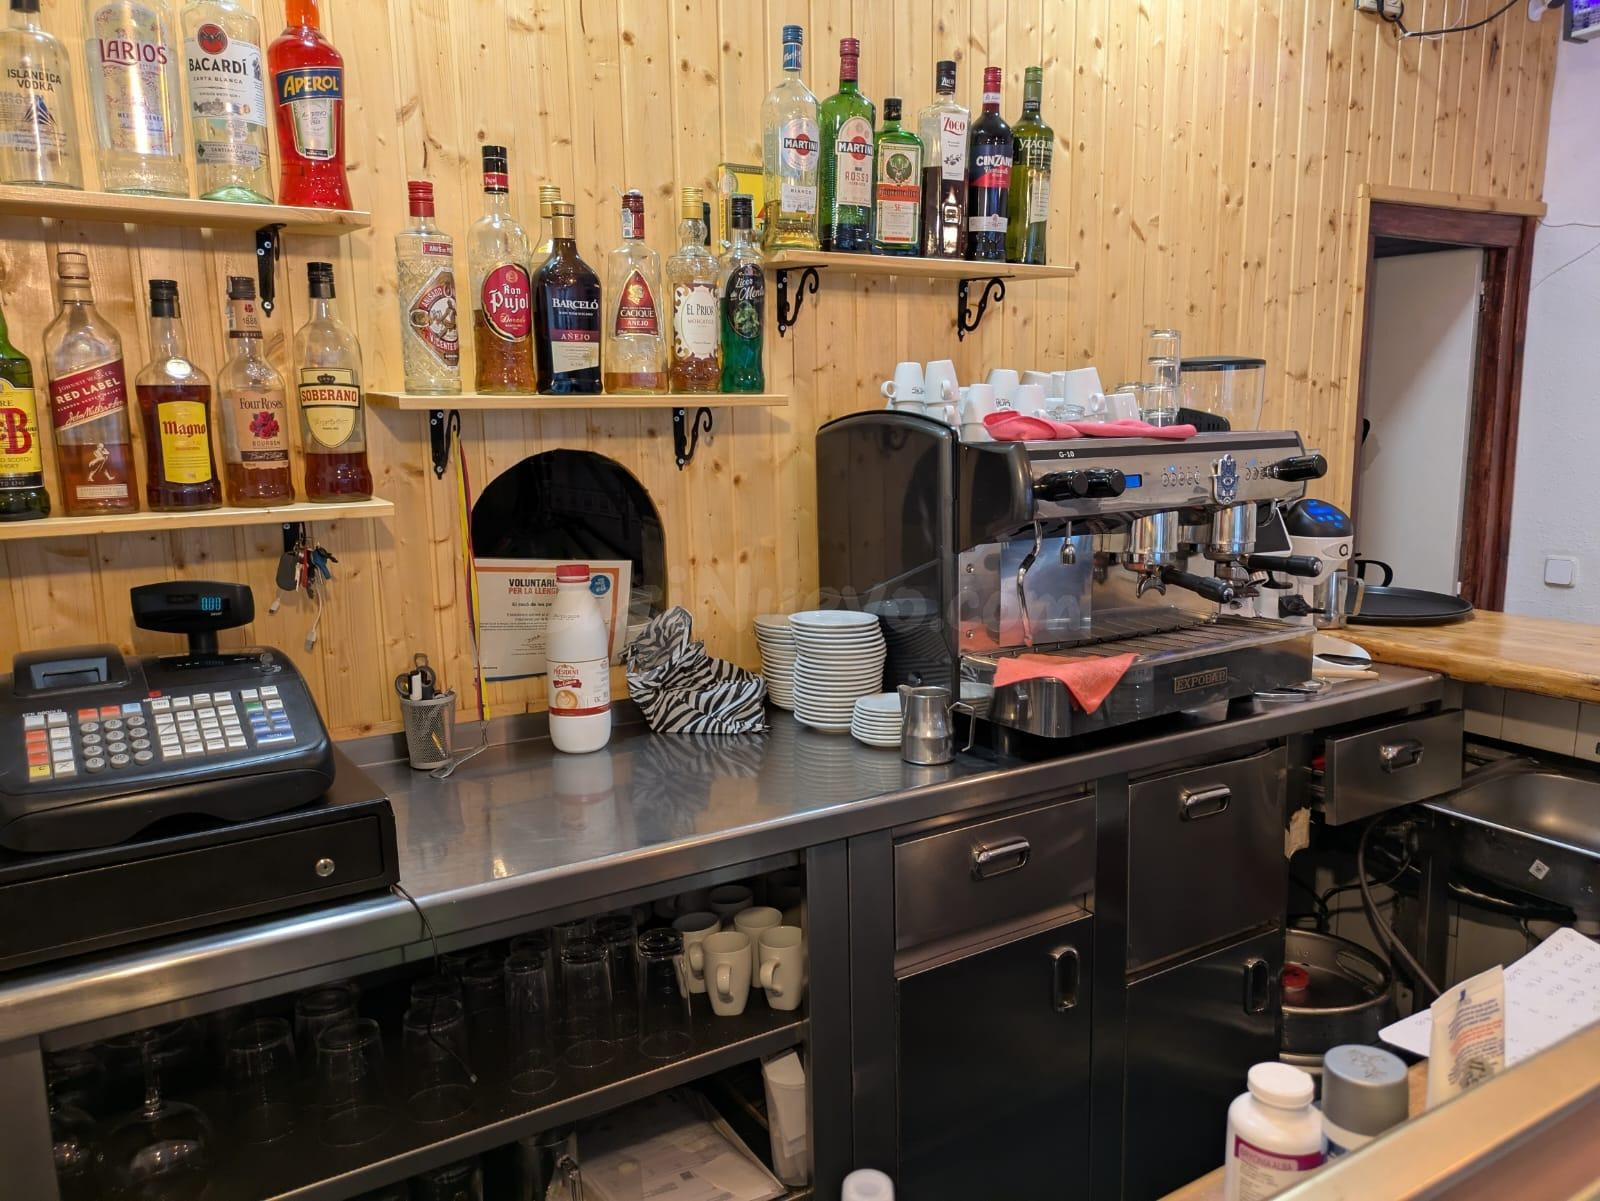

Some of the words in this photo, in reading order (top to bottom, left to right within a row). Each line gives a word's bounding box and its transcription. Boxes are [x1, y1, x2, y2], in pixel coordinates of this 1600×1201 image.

[98, 39, 168, 66] LARIOS
[188, 57, 248, 76] BACARDÍ
[7, 68, 62, 85] ISLANDICA
[16, 79, 54, 93] VODKA
[283, 75, 340, 98] APEROL
[845, 171, 869, 183] ROSSO
[502, 283, 521, 295] Ron
[489, 288, 529, 314] Pujol
[552, 297, 599, 310] BARCELÓ
[620, 309, 656, 318] CACIQUE
[686, 303, 694, 316] EL
[561, 330, 591, 341] AÑEJO
[56, 390, 81, 405] RED
[82, 377, 121, 396] LABEL
[302, 388, 357, 402] SOBERANO
[240, 397, 261, 410] Four
[261, 397, 284, 410] Roses
[162, 420, 207, 438] Magno
[1058, 450, 1075, 459] G-10
[508, 578, 557, 588] VOLUNTARI
